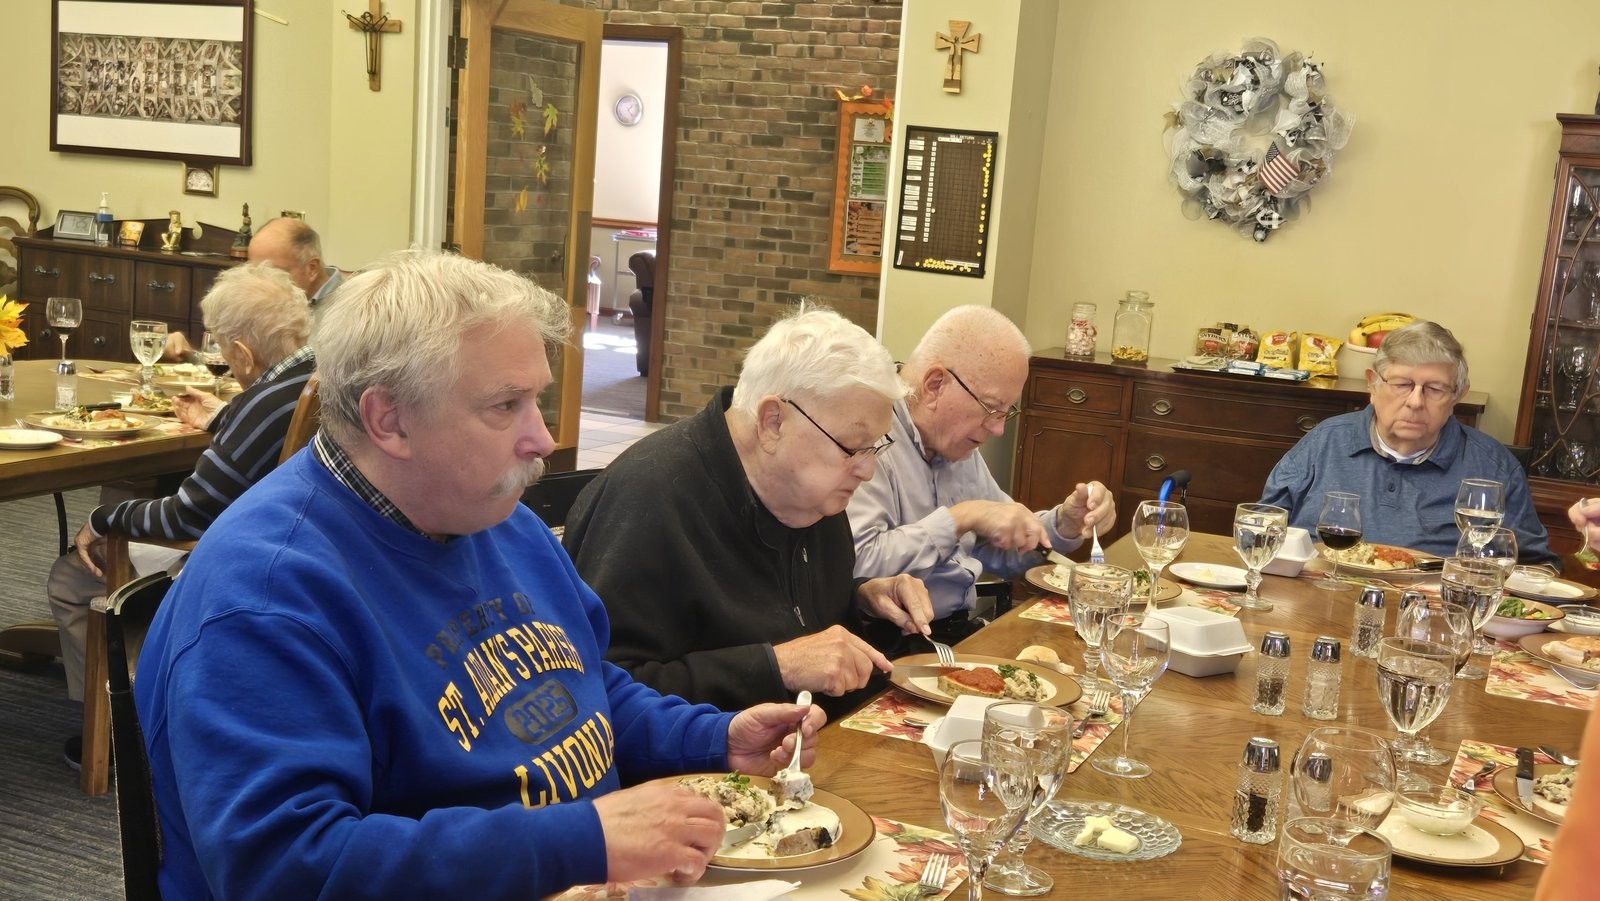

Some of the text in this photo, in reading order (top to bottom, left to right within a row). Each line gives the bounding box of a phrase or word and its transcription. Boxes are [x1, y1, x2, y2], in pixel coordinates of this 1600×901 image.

[512, 591, 535, 615] O
[438, 681, 485, 753] ST.
[514, 711, 614, 810] LIVONIA
